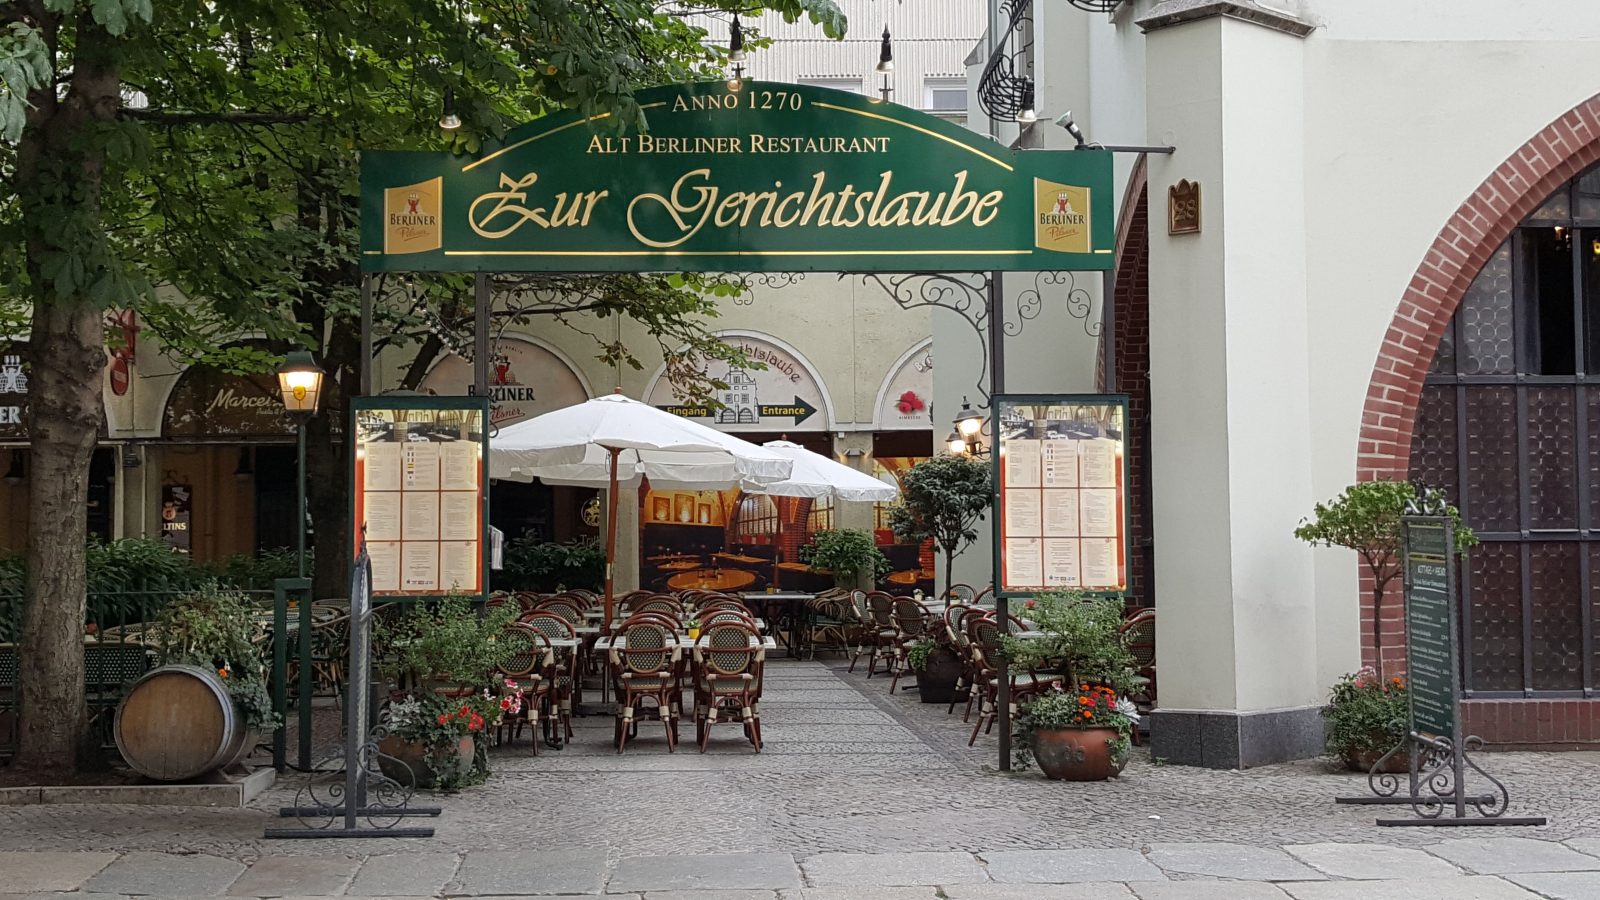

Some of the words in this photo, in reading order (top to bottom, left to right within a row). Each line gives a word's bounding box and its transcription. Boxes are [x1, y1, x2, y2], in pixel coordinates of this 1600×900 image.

[672, 93, 738, 113] ANNO
[748, 90, 802, 111] 1270
[586, 134, 631, 154] ALT
[638, 133, 743, 154] BERLINER
[750, 134, 891, 154] RESTAURANT
[468, 171, 608, 239] Zur
[627, 169, 1004, 248] Gerichtslaube
[390, 213, 436, 226] BERLINER
[1040, 212, 1085, 226] BERLINER
[468, 385, 536, 403] BRLINER
[0, 406, 21, 424] ER
[762, 406, 806, 415] Entrance
